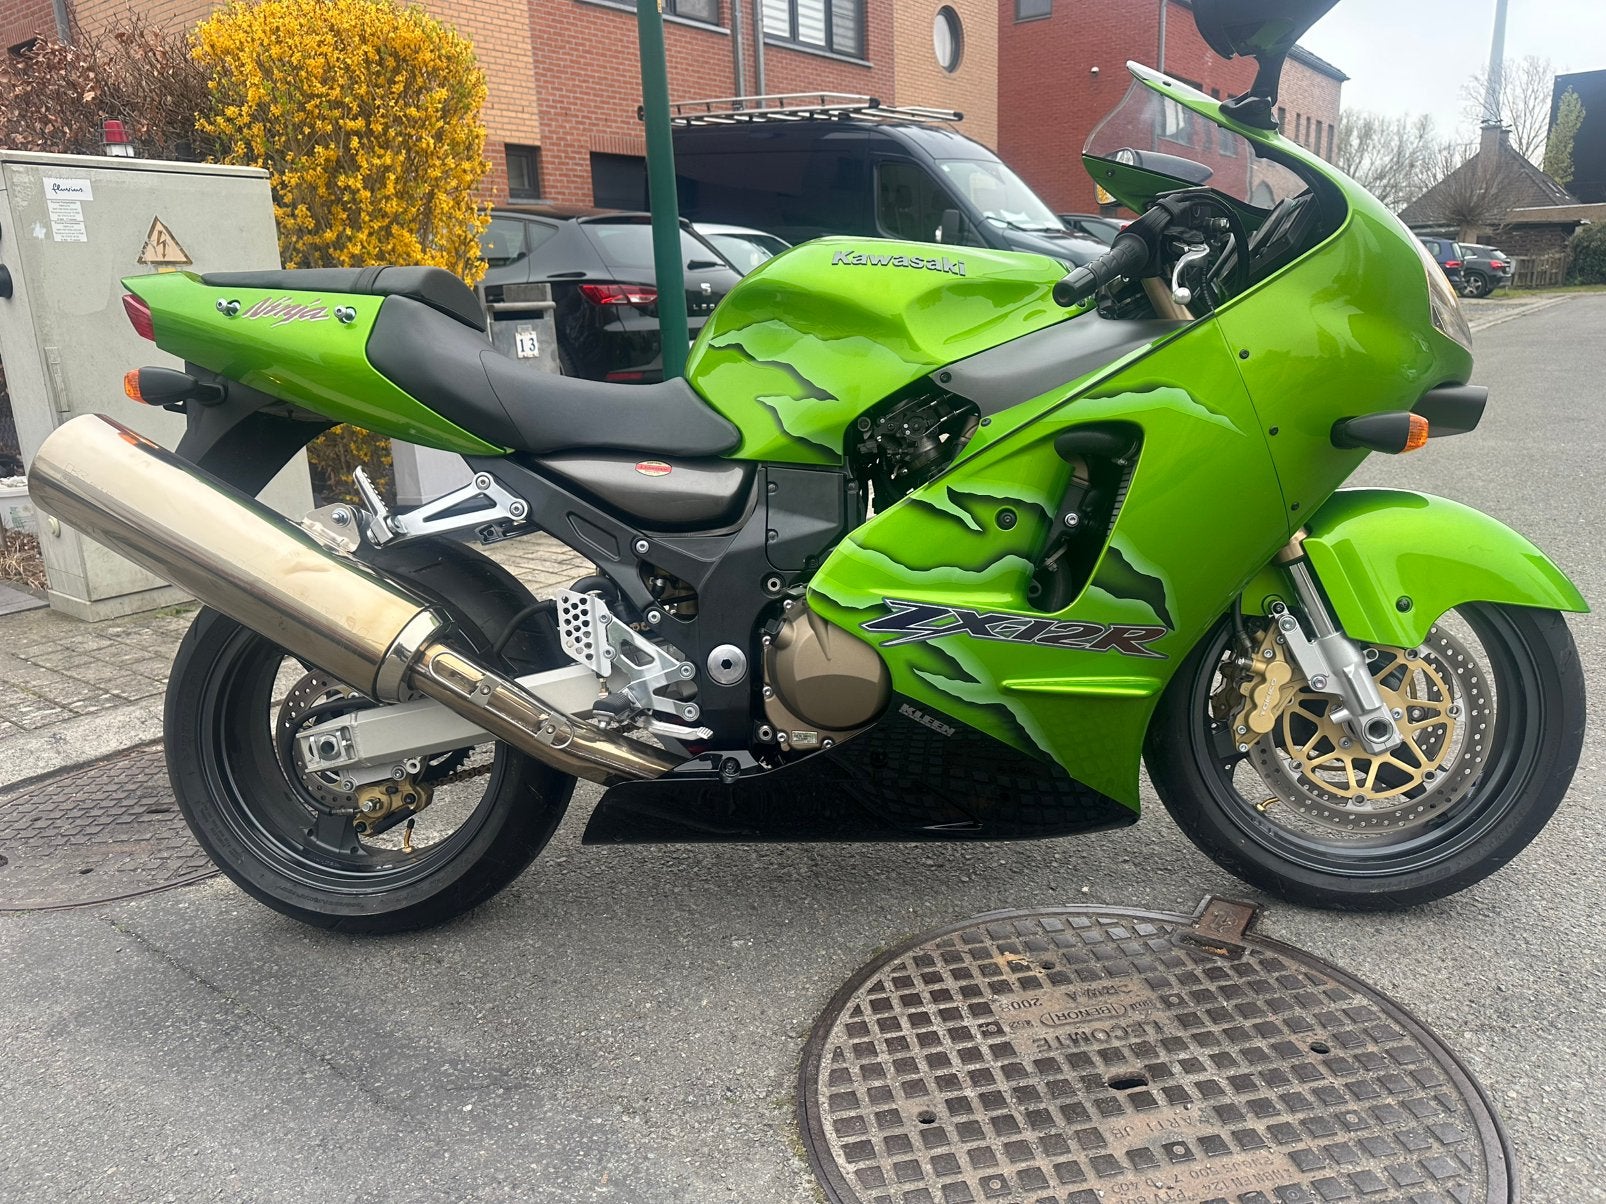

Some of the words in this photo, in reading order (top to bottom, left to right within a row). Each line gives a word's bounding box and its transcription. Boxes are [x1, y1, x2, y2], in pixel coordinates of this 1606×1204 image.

[51, 183, 84, 195] fluvius
[831, 250, 966, 276] Kawasaki
[241, 296, 329, 328] Ninja
[693, 303, 716, 311] LEO
[519, 337, 536, 352] 13
[1054, 1005, 1111, 1021] BENOR
